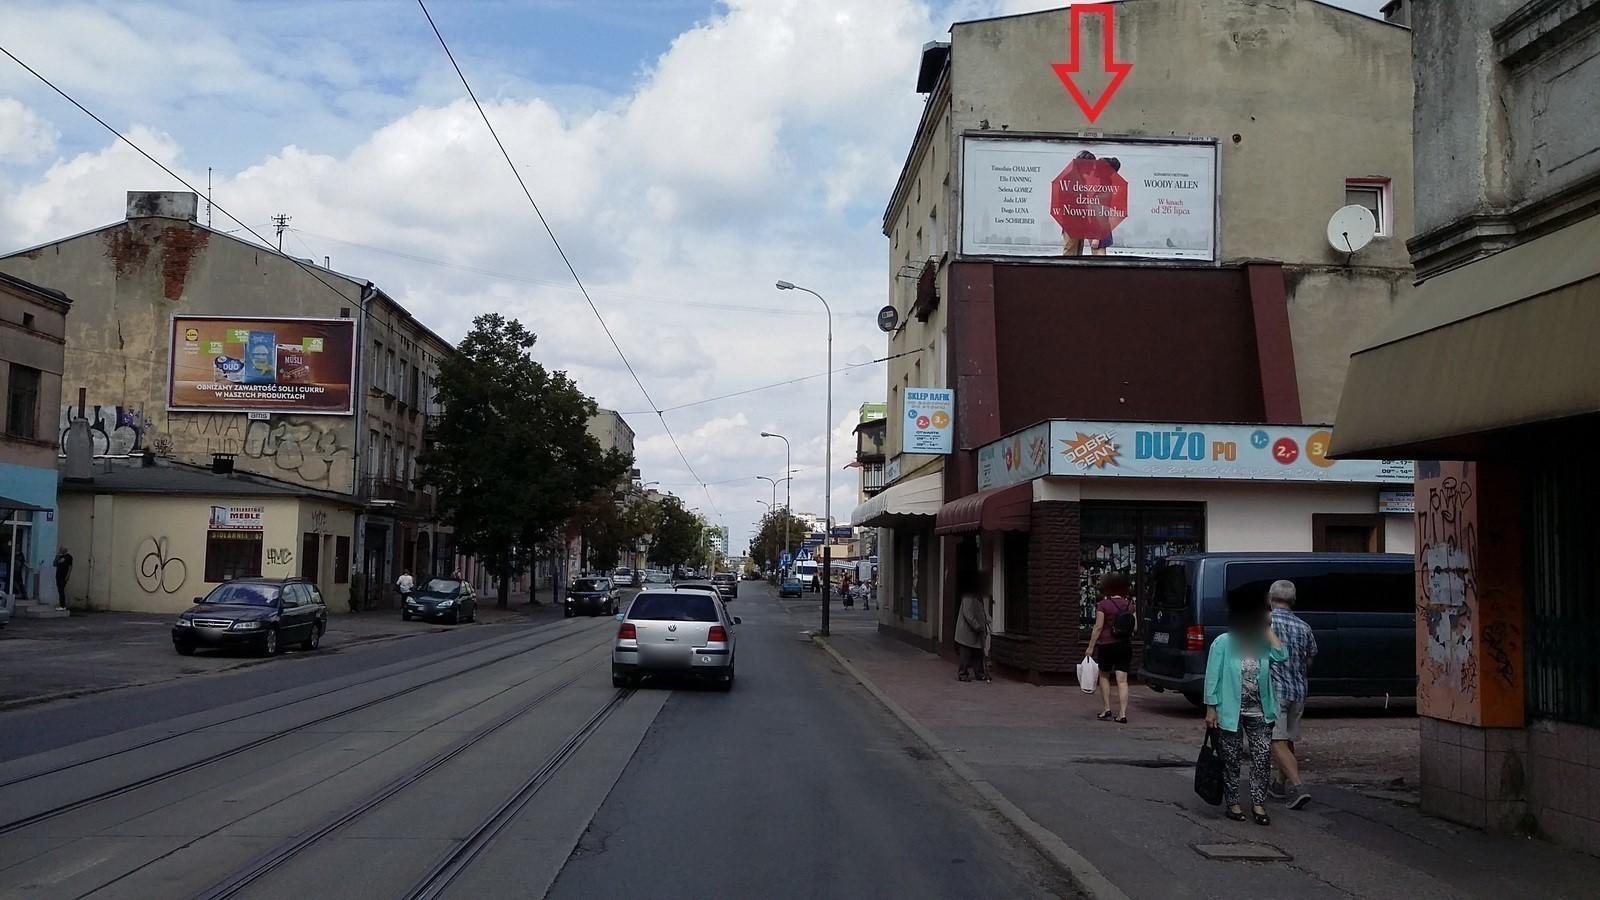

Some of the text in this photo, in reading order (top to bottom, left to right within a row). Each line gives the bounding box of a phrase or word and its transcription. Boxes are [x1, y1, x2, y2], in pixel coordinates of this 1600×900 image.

[1059, 180, 1120, 195] W deszczowy
[1144, 179, 1199, 189] WOODY ALLEN
[1076, 194, 1100, 205] dzień
[1052, 204, 1125, 218] w Nowym Jorku
[1151, 206, 1191, 216] od 26 lipca
[196, 383, 233, 391] OBNIŻAMY
[233, 383, 277, 392] ZAWARTOŚĆ
[907, 392, 950, 401] SKLEP RAFIK
[1063, 428, 1119, 464] DOBRE
[1135, 426, 1237, 461] DUŻO PO
[1074, 441, 1117, 471] CENY
